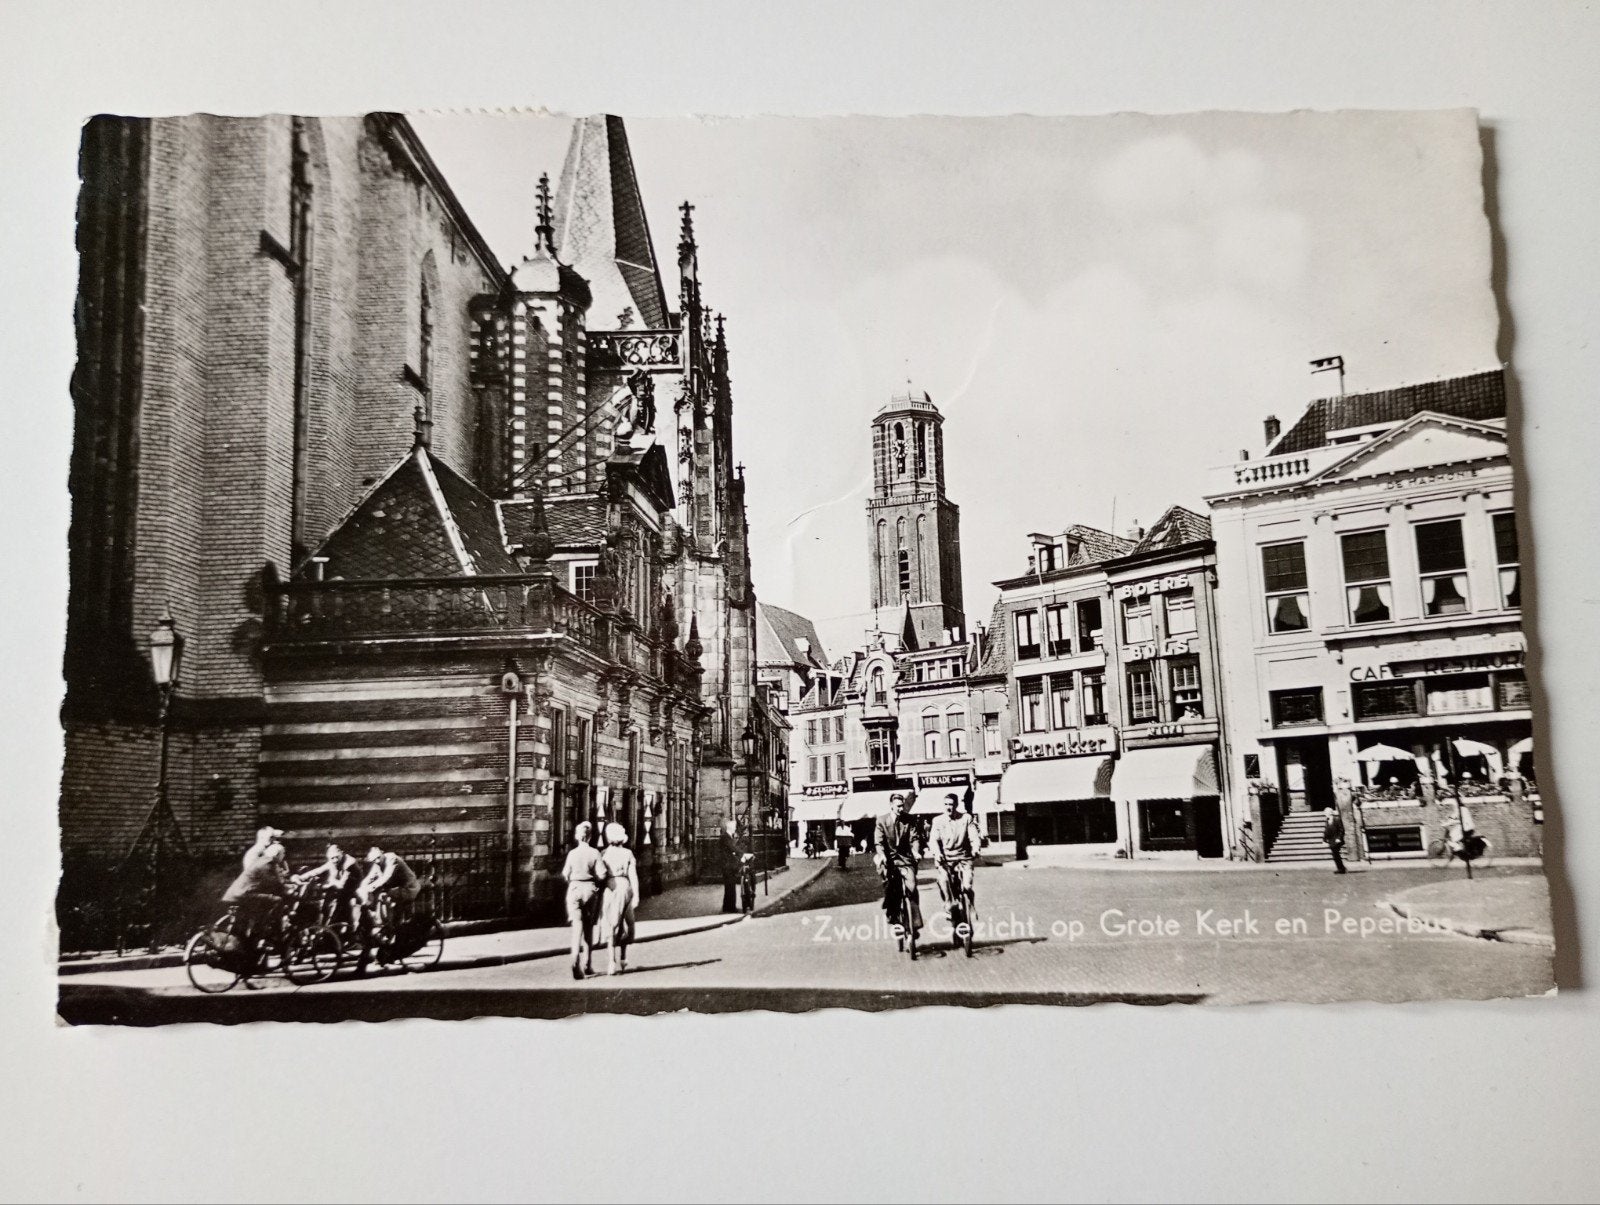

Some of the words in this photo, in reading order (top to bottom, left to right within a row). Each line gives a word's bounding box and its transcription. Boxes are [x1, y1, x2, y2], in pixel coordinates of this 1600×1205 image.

[1121, 574, 1189, 600] BOERS
[1130, 639, 1189, 661] BOLS
[1008, 731, 1107, 759] Paanakker
[921, 775, 951, 785] VERKADE
